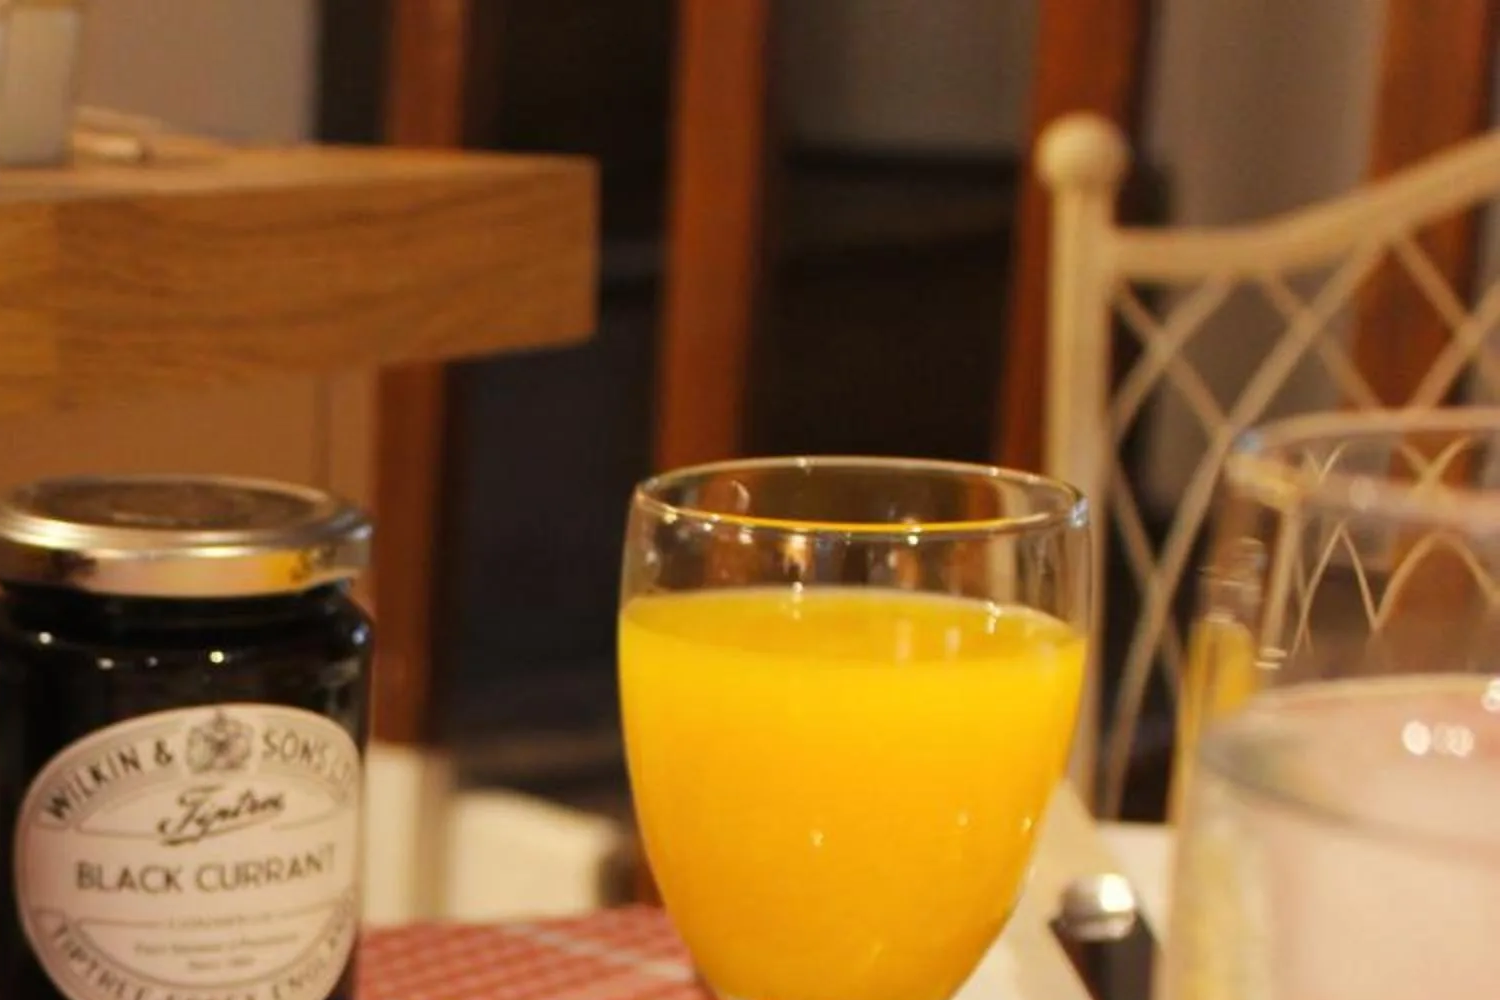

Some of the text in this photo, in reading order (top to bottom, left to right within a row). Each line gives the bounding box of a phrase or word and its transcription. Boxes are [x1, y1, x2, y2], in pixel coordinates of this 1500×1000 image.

[47, 743, 143, 821] WILKIN
[154, 739, 174, 767] &
[156, 785, 285, 847] Tiptree
[75, 842, 336, 894] BLACK CURRANT
